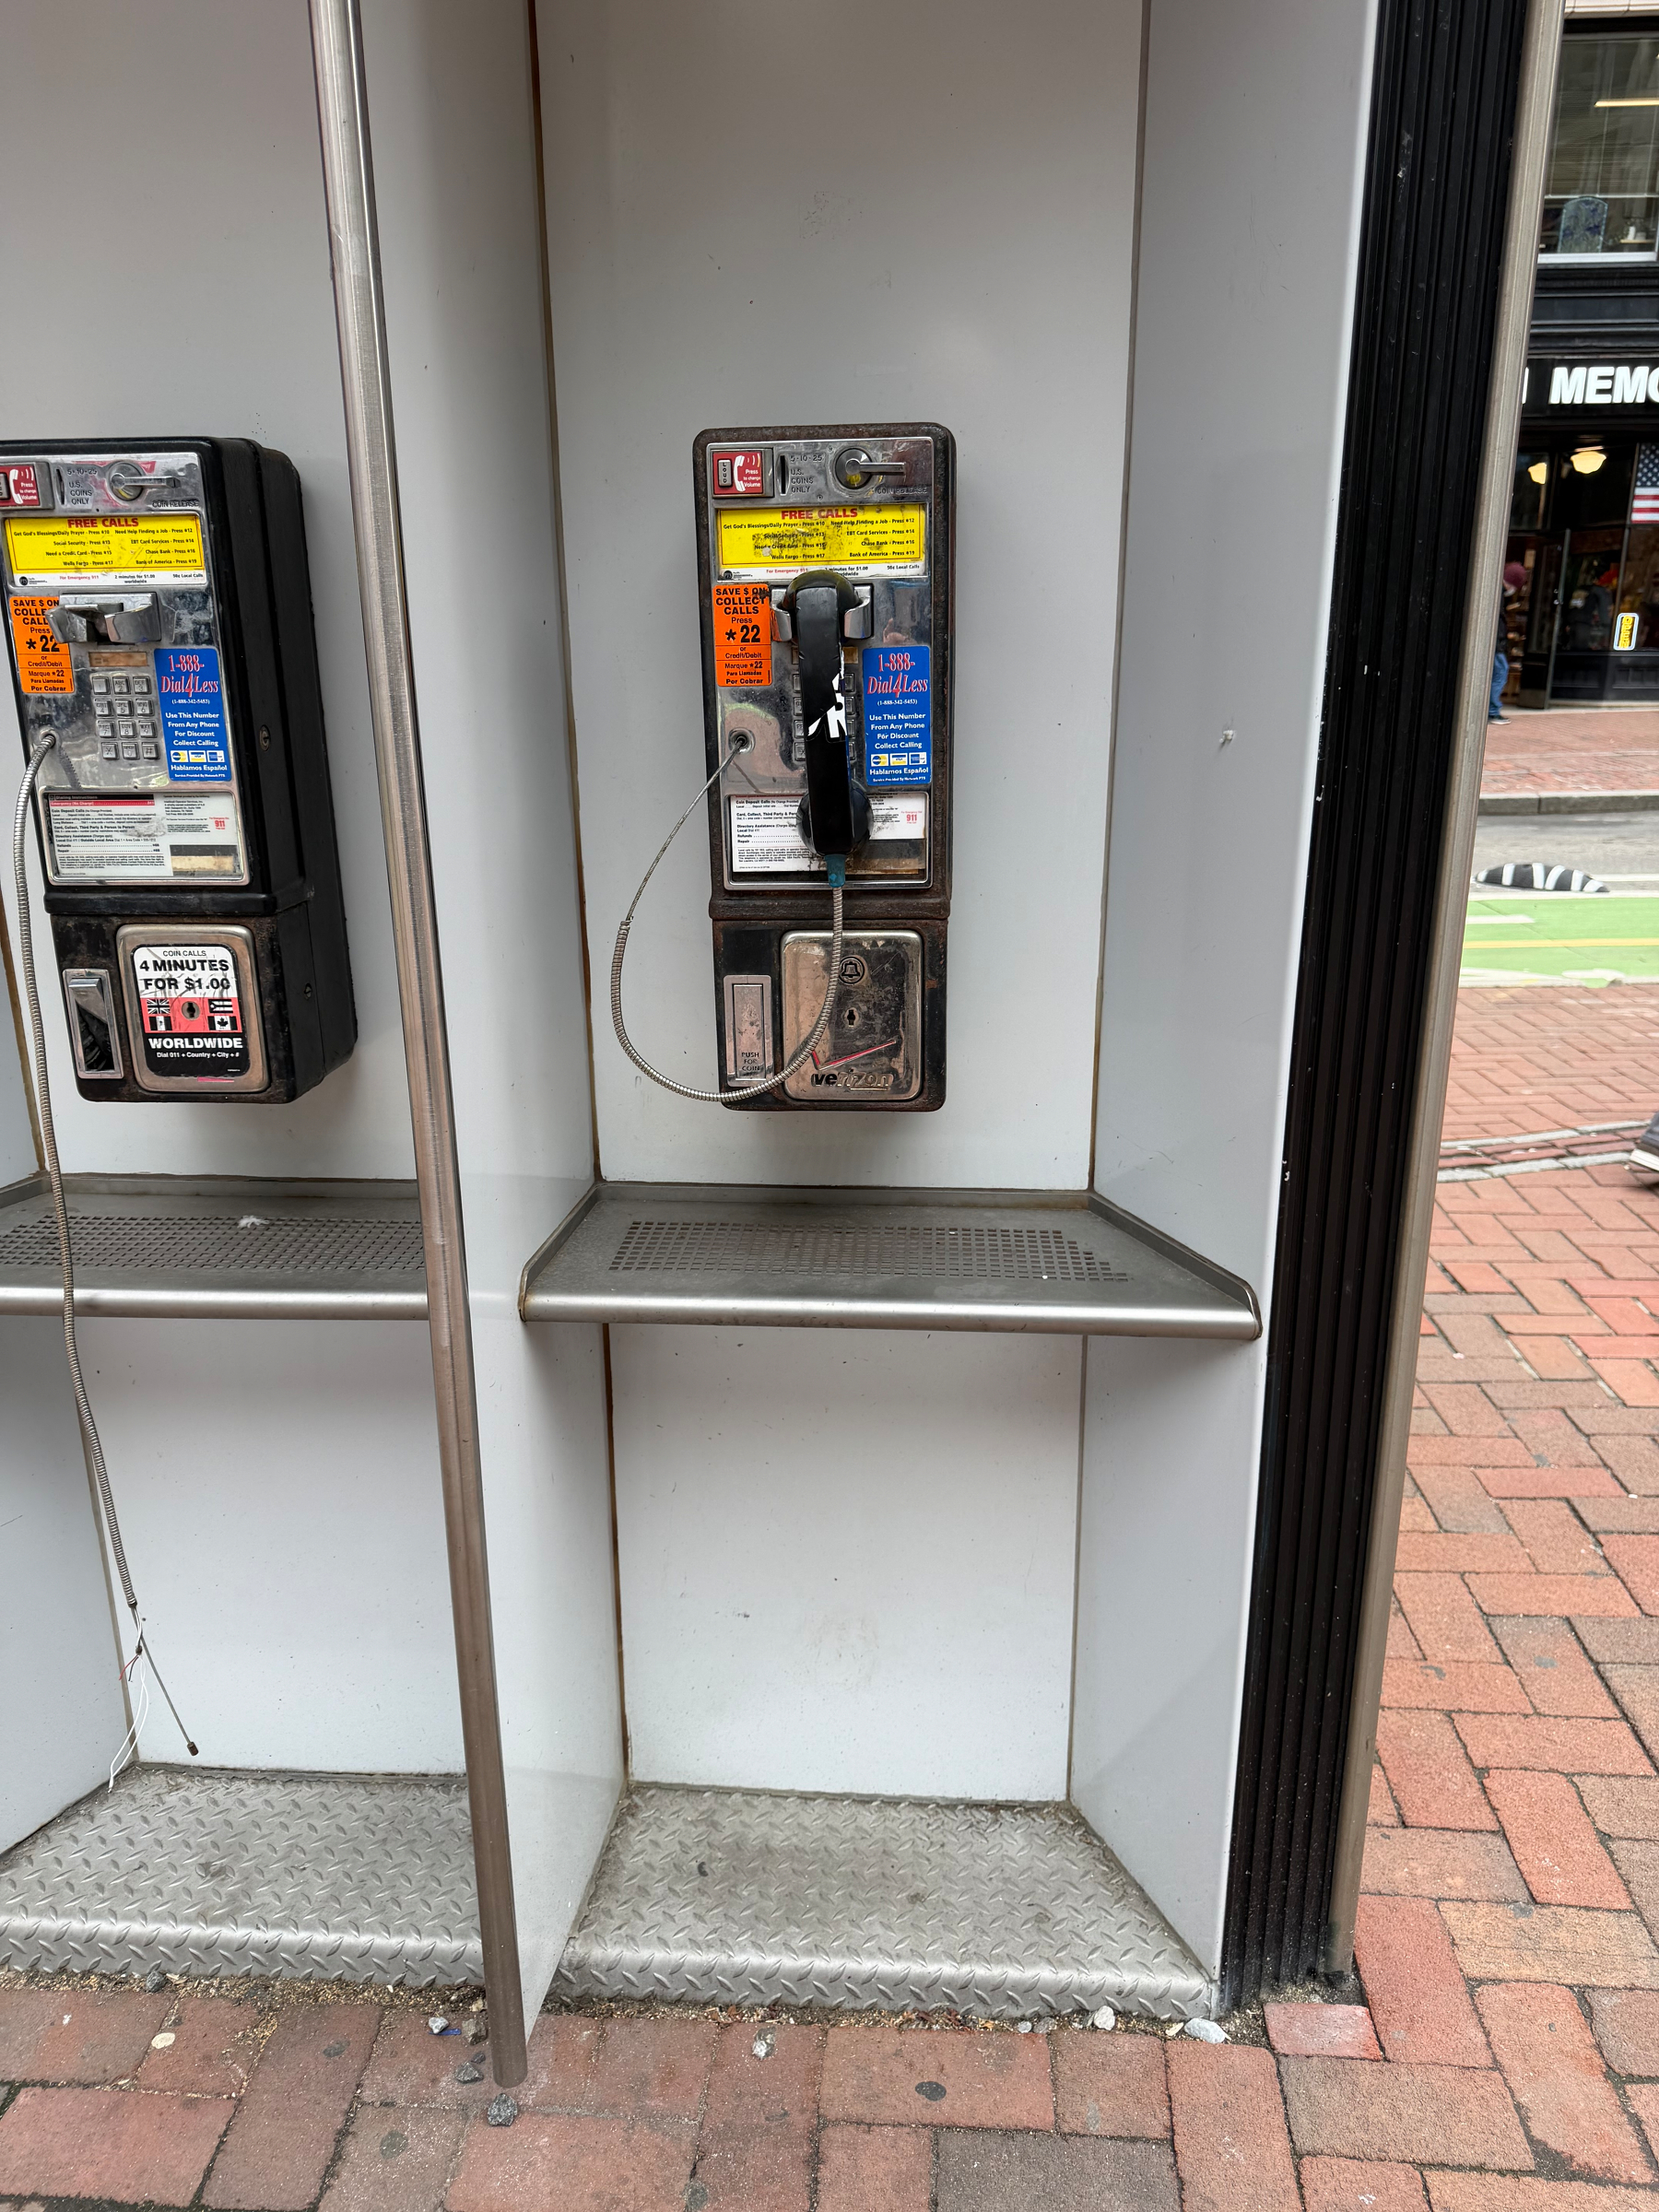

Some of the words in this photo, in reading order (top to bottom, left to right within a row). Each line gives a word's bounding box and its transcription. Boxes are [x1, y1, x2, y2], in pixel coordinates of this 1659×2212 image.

[781, 510, 813, 519] FREE
[818, 508, 857, 518] CALLS
[67, 519, 97, 528] FREE
[102, 518, 138, 527] CALLS
[716, 597, 765, 605] COLLECT
[724, 607, 759, 615] CALLS
[169, 655, 204, 672] 1-888-
[878, 653, 915, 672] 1-888-
[140, 961, 149, 971] 4
[153, 960, 229, 971] MINUTES
[144, 979, 178, 990] FOR
[185, 977, 230, 990] $1.00
[149, 1038, 242, 1048] WORLDWIDE
[813, 1069, 890, 1086] verizon
